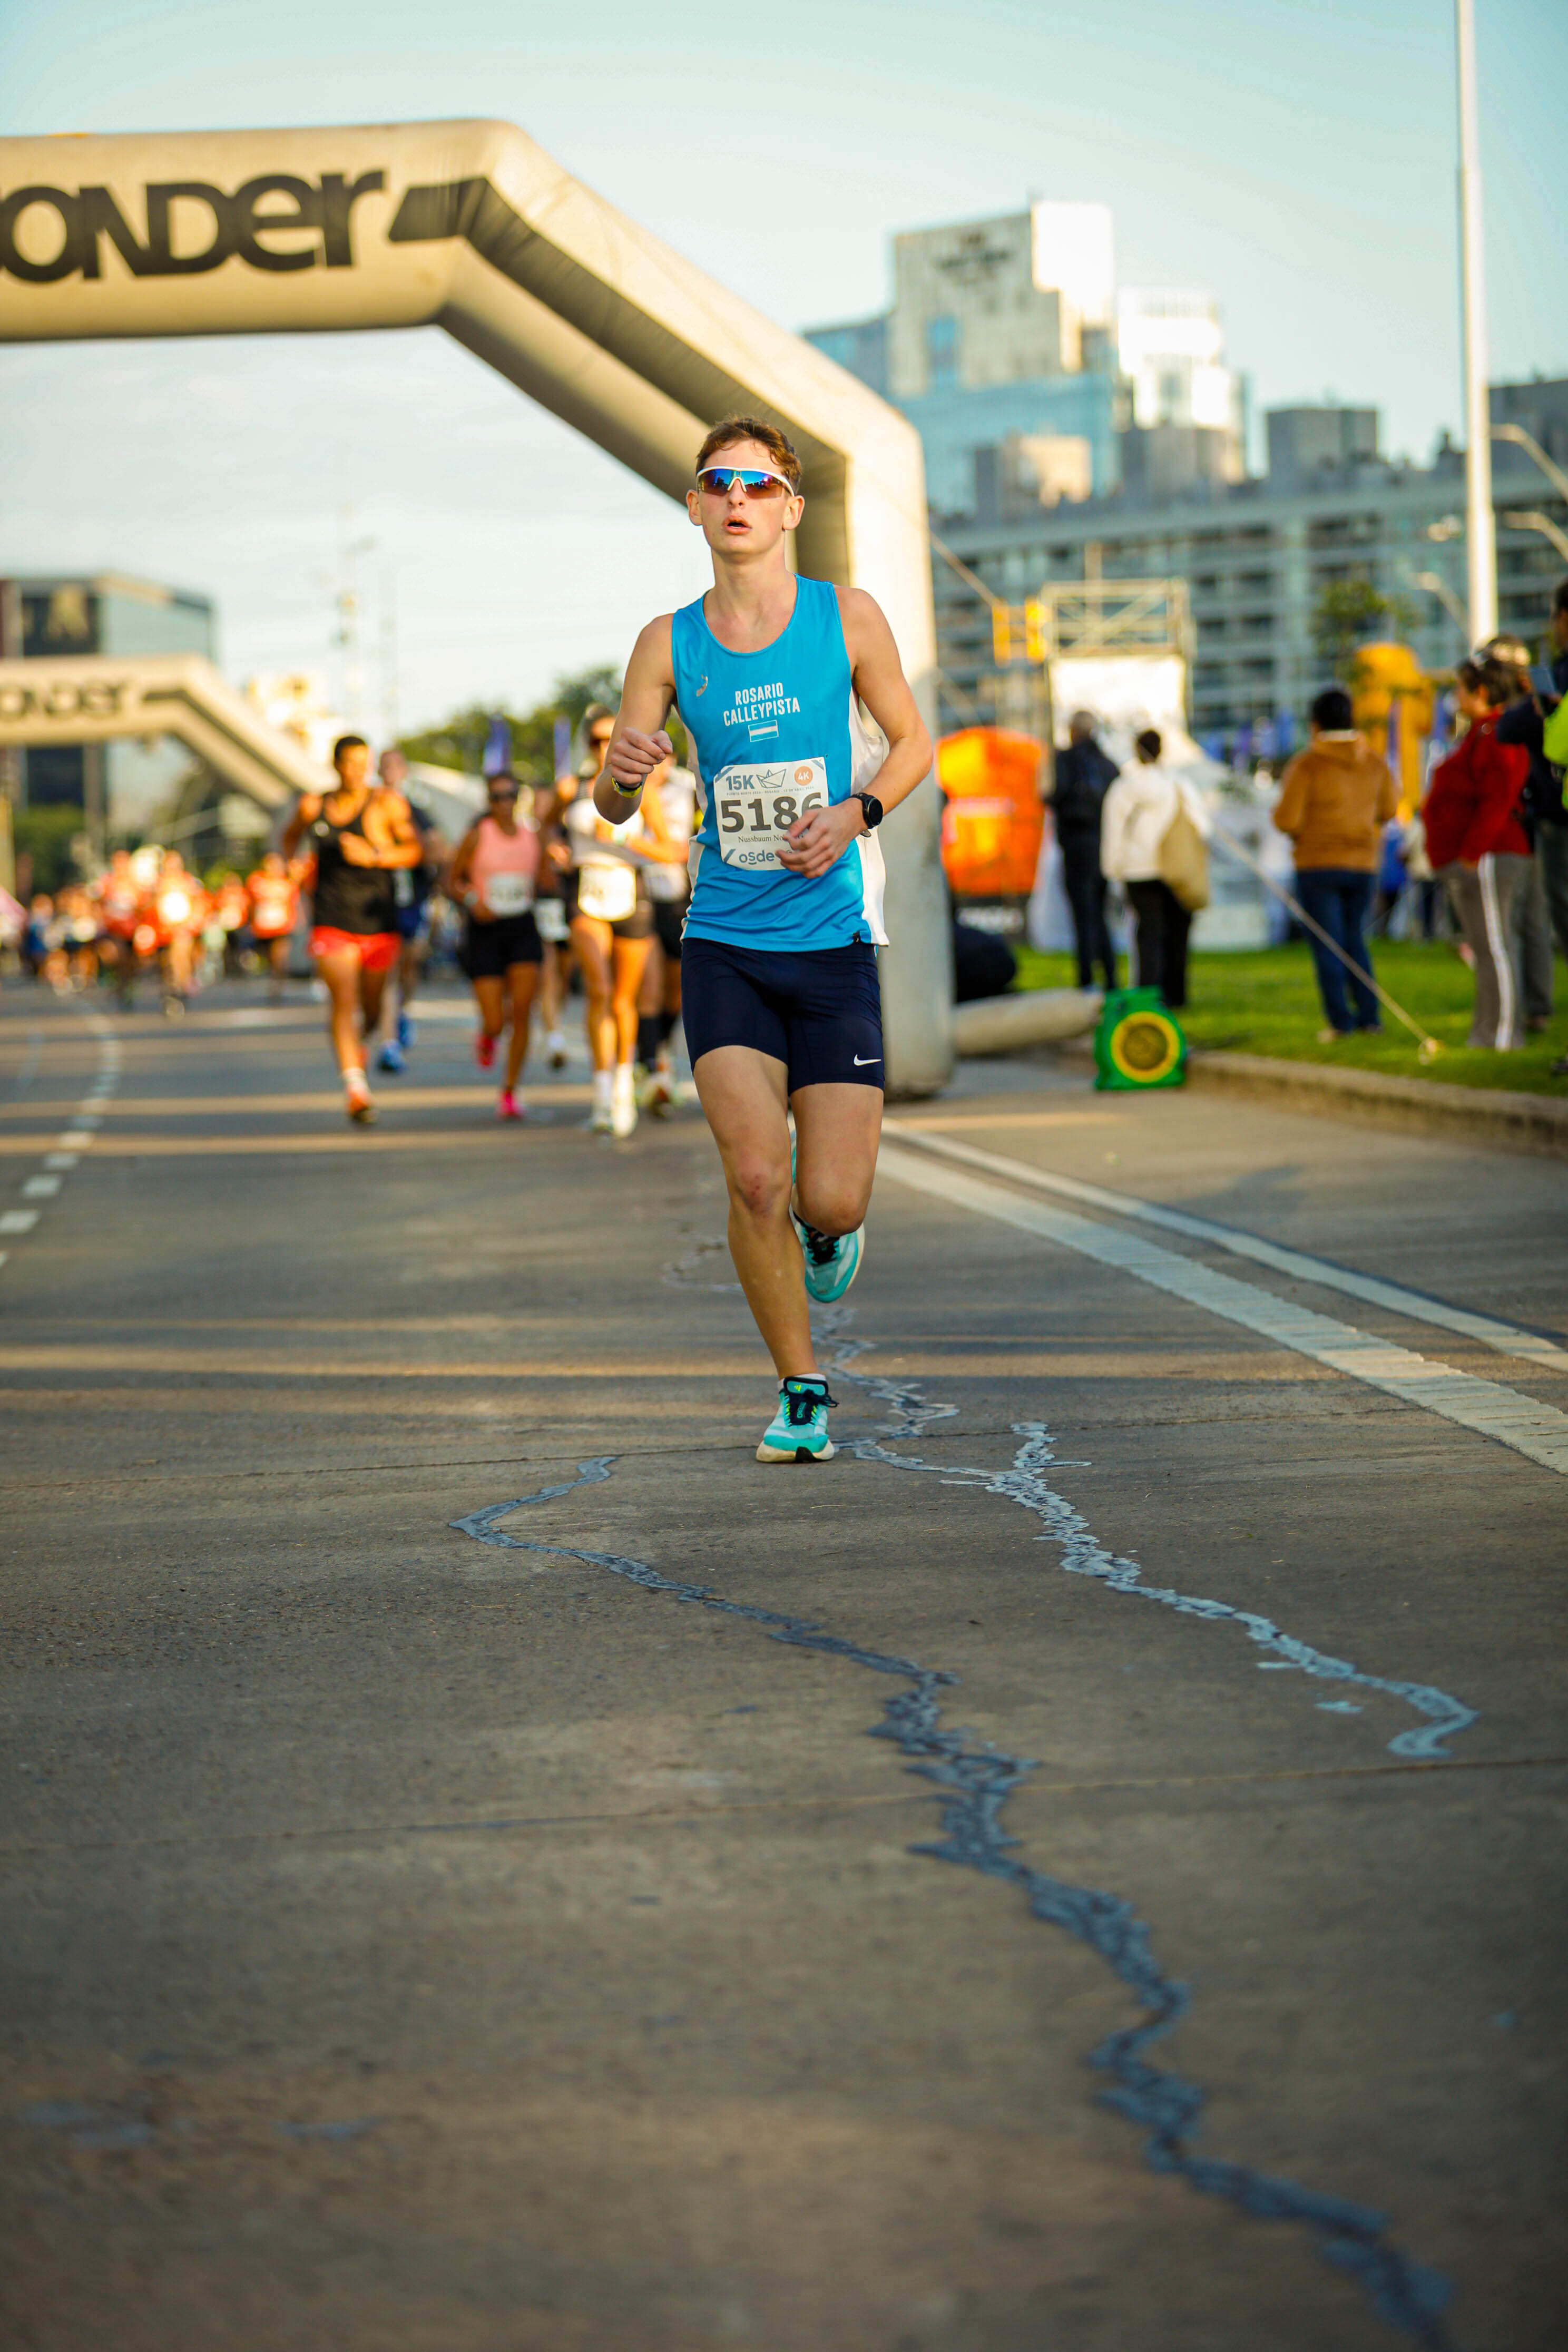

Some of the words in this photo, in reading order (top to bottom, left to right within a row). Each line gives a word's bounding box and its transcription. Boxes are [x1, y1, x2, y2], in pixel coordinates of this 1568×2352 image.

[734, 682, 784, 706] ROSARIO
[723, 697, 801, 727] CALLEYPISTA
[726, 774, 755, 791] 15K
[798, 771, 810, 781] 4K
[737, 835, 772, 843] Nussbaum
[738, 849, 775, 865] osde
